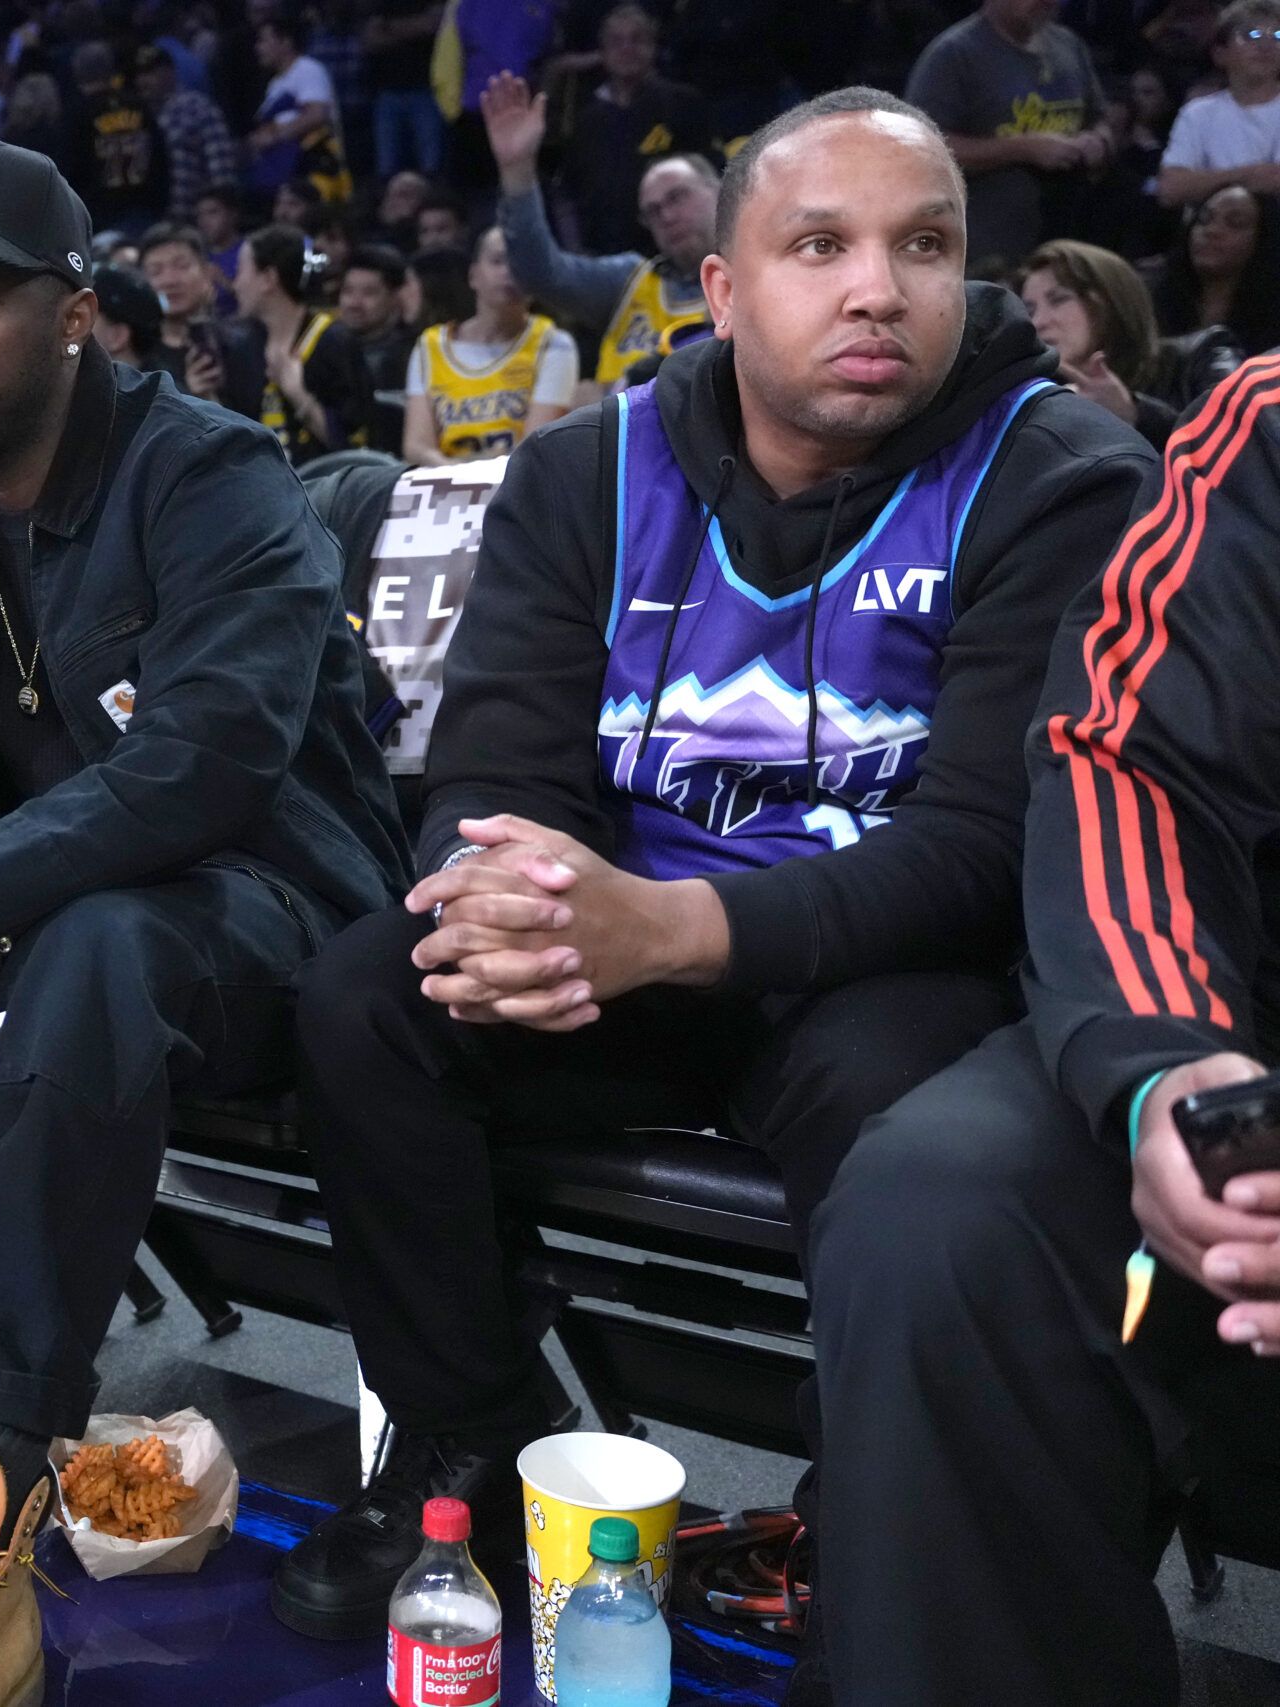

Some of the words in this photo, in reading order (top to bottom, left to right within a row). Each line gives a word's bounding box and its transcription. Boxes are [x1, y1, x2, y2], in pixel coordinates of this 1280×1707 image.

[852, 568, 948, 613] LVT
[425, 1654, 446, 1668] I'm
[447, 1659, 456, 1669] a
[425, 1667, 484, 1684] Recycled
